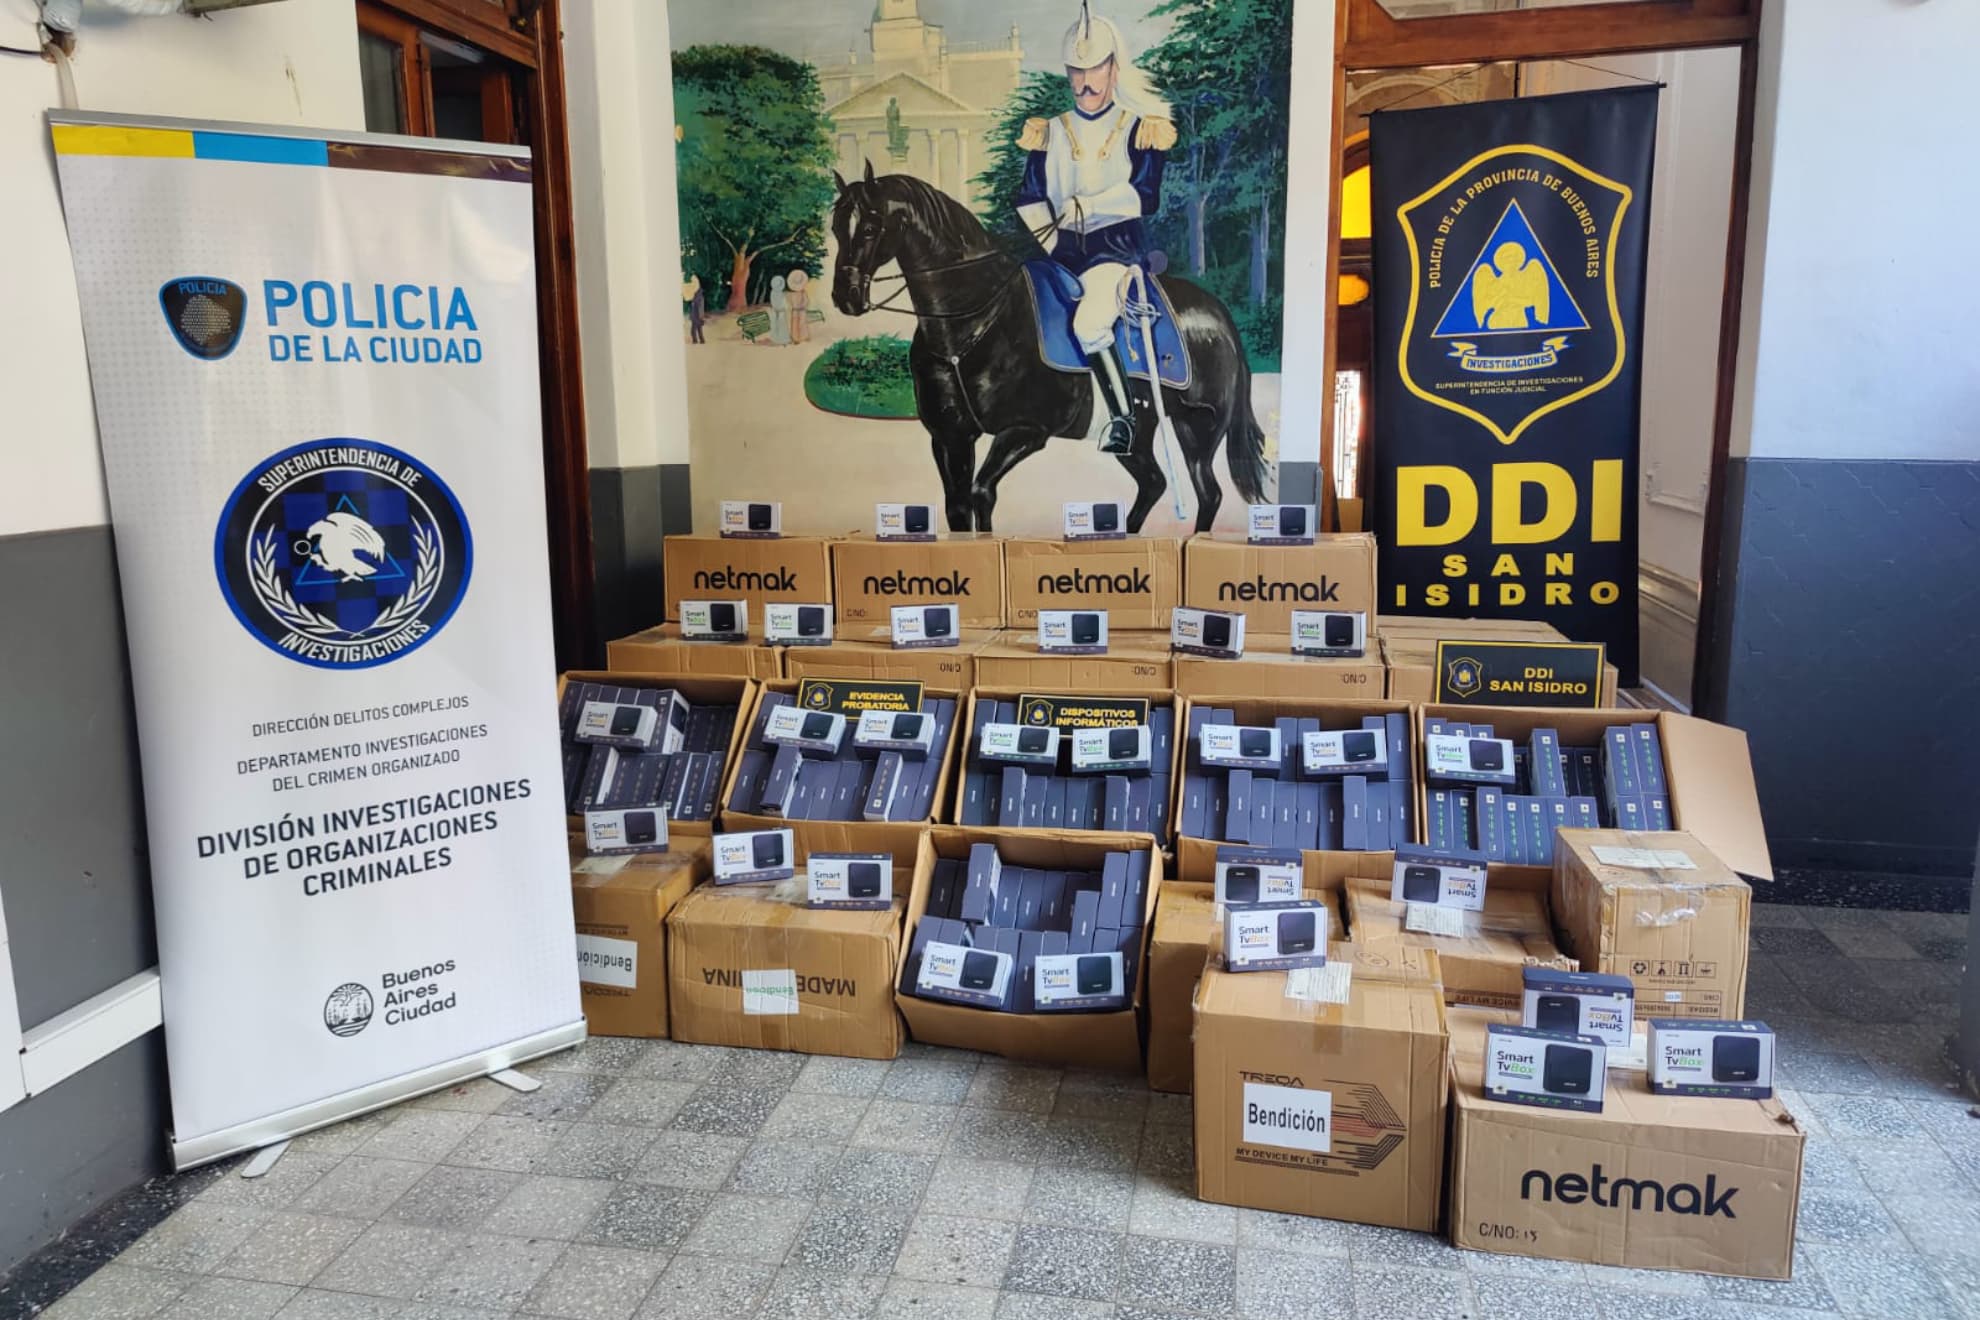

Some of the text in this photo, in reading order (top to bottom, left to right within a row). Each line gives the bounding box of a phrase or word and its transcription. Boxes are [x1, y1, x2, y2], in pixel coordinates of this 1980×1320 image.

[1428, 168, 1600, 288] POLICIA DE LA PROVINCIA DE BUENOS AIRES
[178, 281, 227, 296] POLICIA
[263, 279, 478, 331] POLICIA
[269, 334, 482, 364] DE LA CIUDAD
[1466, 353, 1553, 369] INVESTIGACIONES
[1506, 379, 1517, 387] DE
[1517, 375, 1584, 386] INVESTIGACIONES
[257, 447, 423, 493] SUPERINTENDENCIA DE
[1396, 458, 1624, 547] DDI
[1442, 552, 1574, 577] SAN
[694, 565, 798, 592] netmak
[863, 570, 971, 596] netmak
[1038, 567, 1151, 594] netmak
[1218, 574, 1340, 602] netmak
[1396, 581, 1621, 607] ISIDRO
[277, 618, 431, 663] INVESTIGACIONES
[1524, 667, 1554, 679] DDI
[849, 691, 905, 701] EVIDENCIA
[1489, 680, 1587, 694] SAN ISIDRO
[252, 695, 470, 737] DIRECCIÓN DELITOS COMPLEJOS
[841, 700, 910, 711] PROBATORIA
[1060, 707, 1137, 718] DISPOSITIVOS
[237, 724, 488, 775] DEPARTAMENTO INVESTIGACIONES
[272, 749, 460, 792] DEL CRIMEN ORGANIZADO
[197, 778, 532, 858] DIVISIÓN INVESTIGACIONES
[244, 811, 498, 880] DE ORGANIZACIONES
[303, 847, 452, 896] CRIMINALES
[1239, 926, 1269, 935] Smart
[382, 960, 456, 989] Buenos
[796, 975, 855, 997] MADE
[383, 983, 439, 1008] Aires
[385, 991, 457, 1026] Ciudad
[1589, 1021, 1624, 1032] Smart
[1497, 1050, 1534, 1065] Smart
[1665, 1045, 1702, 1056] Smart
[1665, 1056, 1704, 1066] TvBox
[1497, 1061, 1536, 1075] TvBox
[1248, 1102, 1325, 1133] Bendición
[1236, 1148, 1328, 1166] MY DEVICE MY LIFE
[1521, 1164, 1739, 1219] netmak
[1479, 1222, 1519, 1239] C/NO:
